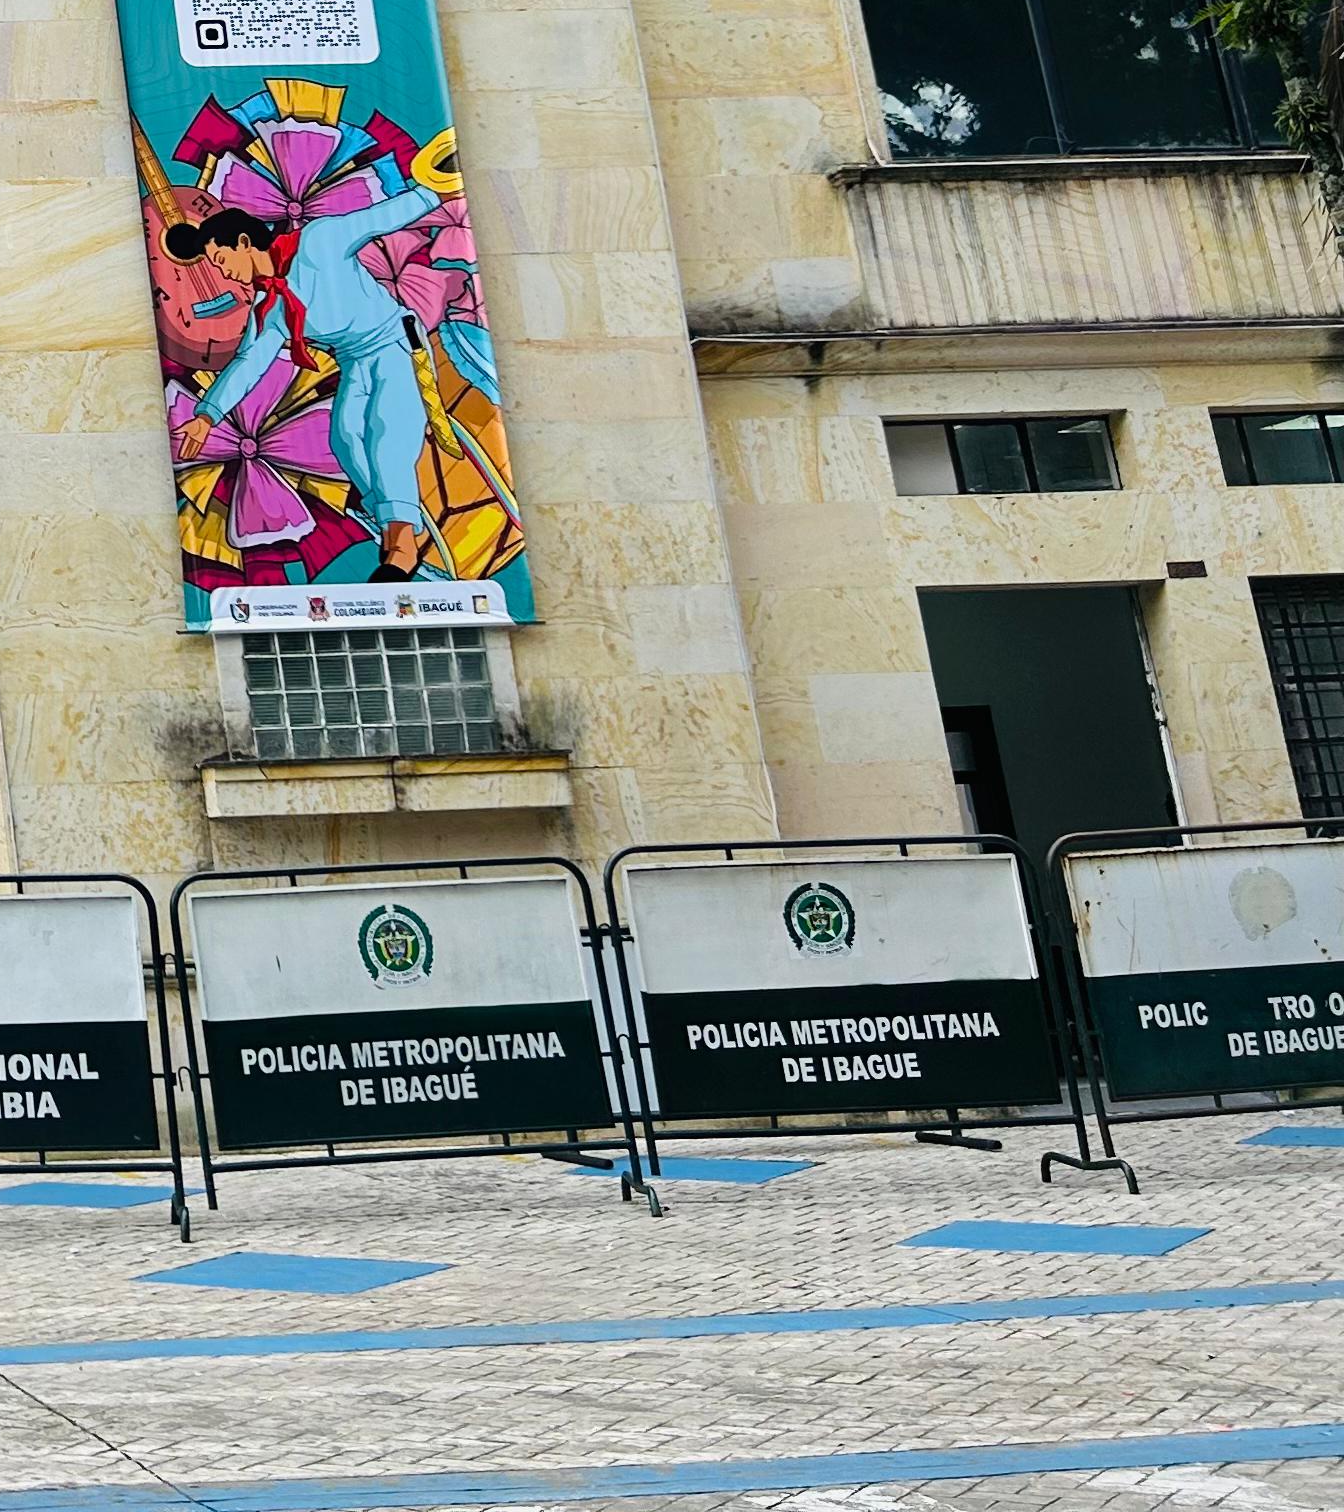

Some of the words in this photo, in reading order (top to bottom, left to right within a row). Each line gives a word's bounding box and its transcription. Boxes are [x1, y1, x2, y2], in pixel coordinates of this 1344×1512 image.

[418, 600, 464, 613] IBAGUÉ
[686, 1021, 787, 1050] POLICIA
[791, 1012, 1001, 1046] METROPOLITANA
[1227, 1031, 1260, 1057] DE
[1263, 1025, 1344, 1055] IBAGUE
[240, 1043, 346, 1076] POLICIA
[352, 1031, 566, 1069] METROPOLITANA
[781, 1057, 818, 1083] DE
[822, 1052, 922, 1082] IBAGUE
[340, 1078, 377, 1107] DE
[382, 1064, 479, 1104] IBAGUÉ
